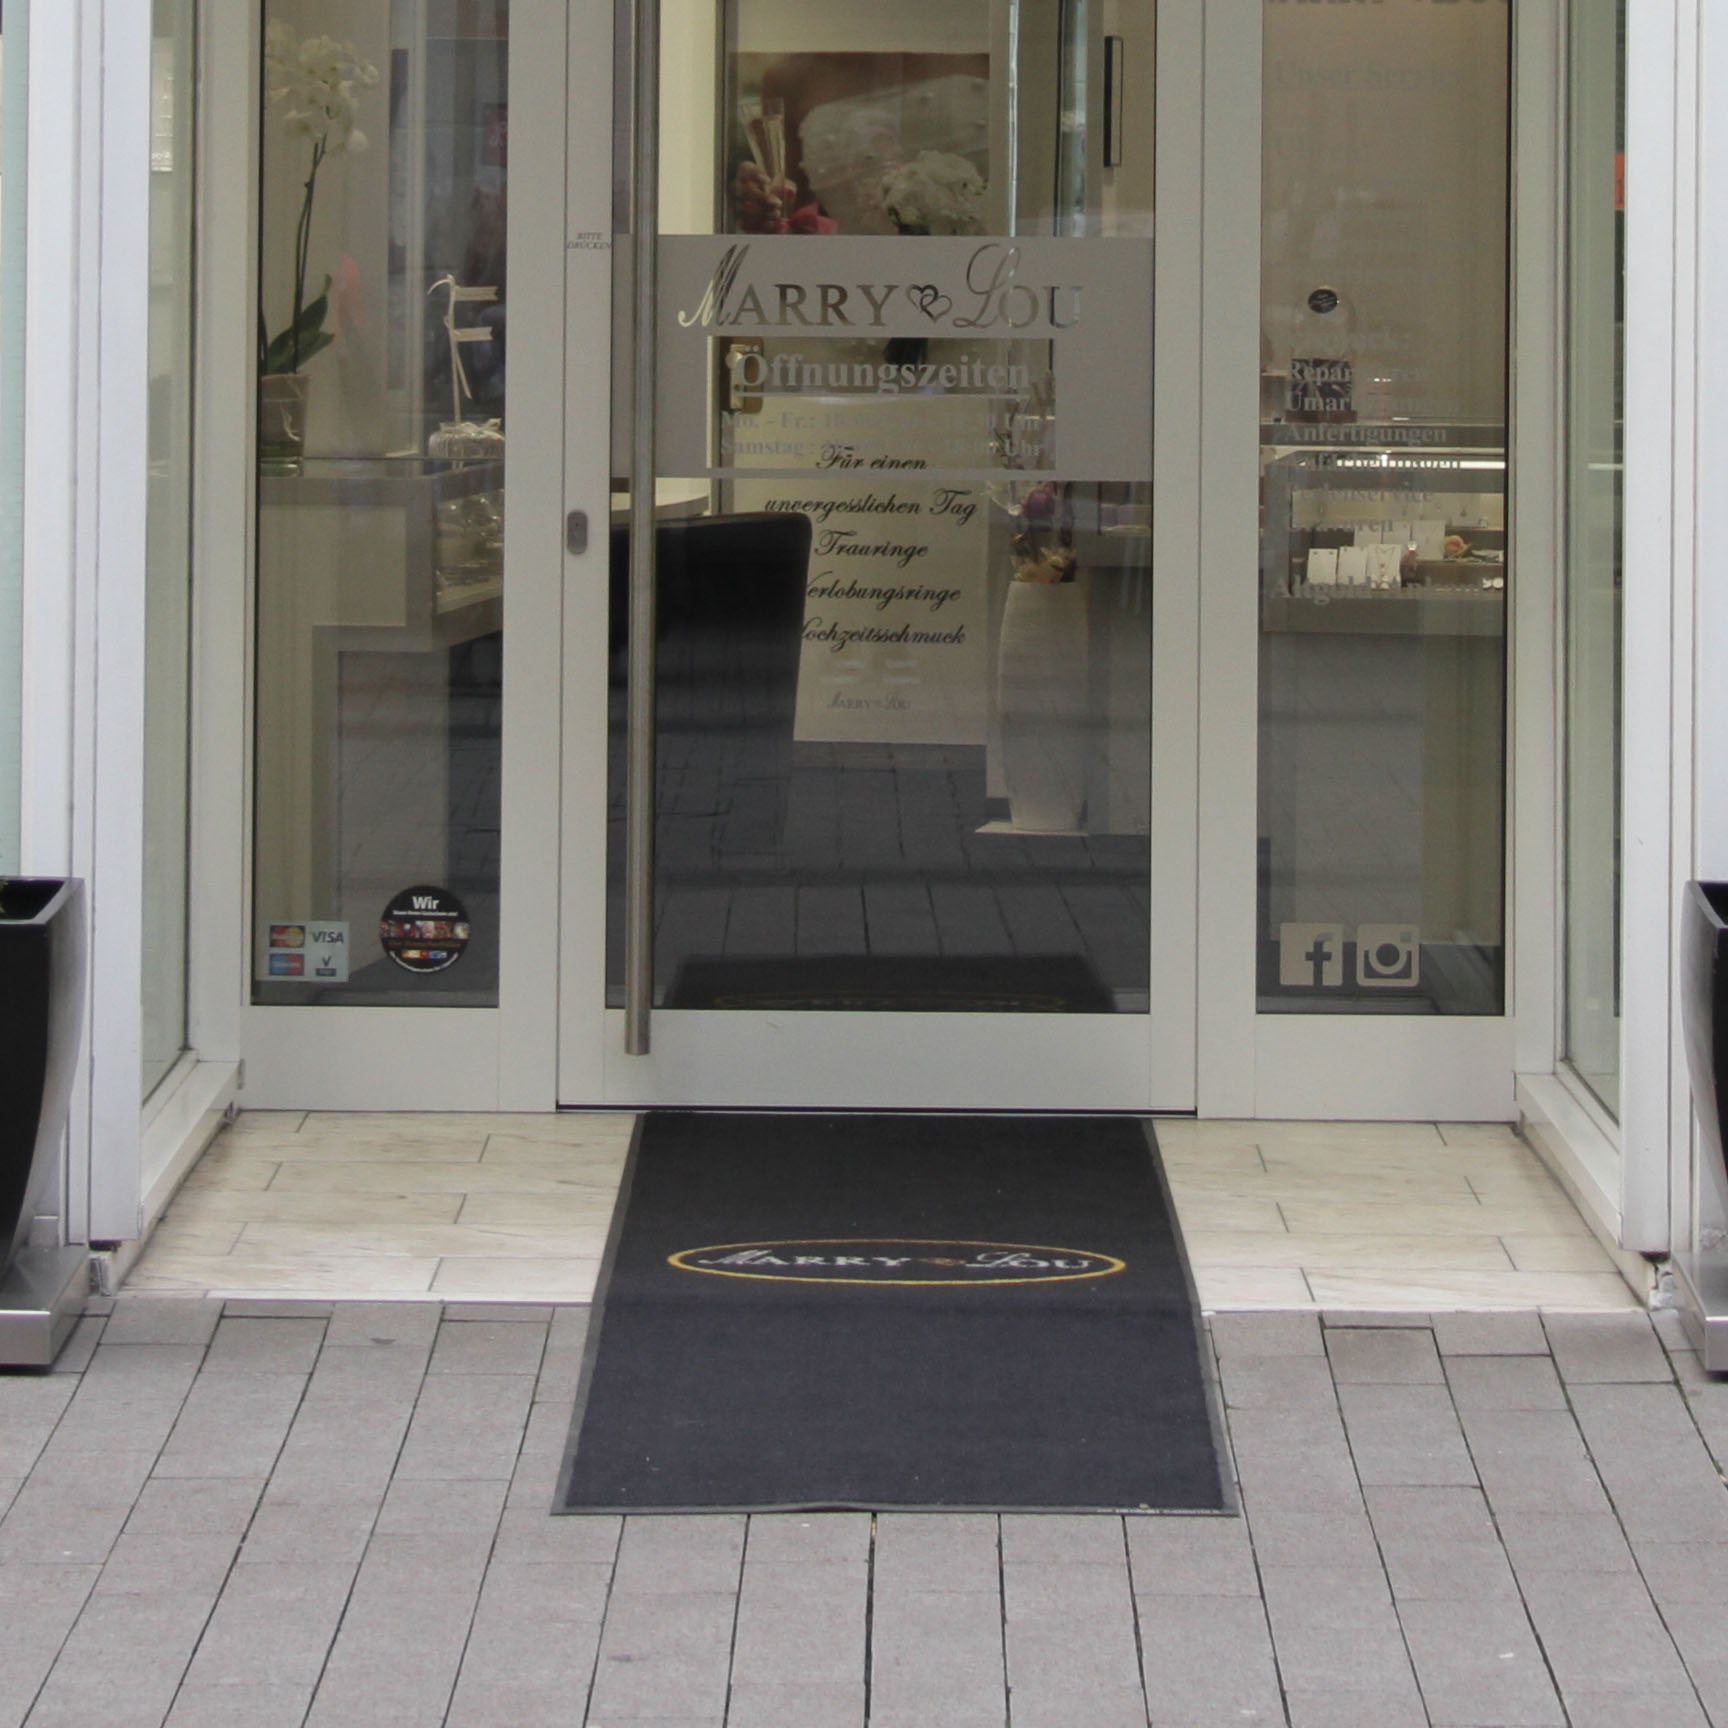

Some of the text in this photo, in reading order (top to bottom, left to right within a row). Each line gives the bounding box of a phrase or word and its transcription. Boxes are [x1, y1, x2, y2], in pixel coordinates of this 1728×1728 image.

[677, 242, 1084, 329] MARRY LOU
[734, 345, 1030, 395] Öffnungszeiten
[1284, 423, 1448, 446] Anfertigungen
[816, 445, 927, 471] Für einen
[765, 488, 978, 523] unvergesslichen Tag
[813, 529, 928, 571] Trauringe
[411, 895, 440, 910] Wir
[312, 930, 345, 944] VISA
[698, 1249, 1092, 1269] MARRY LOU
